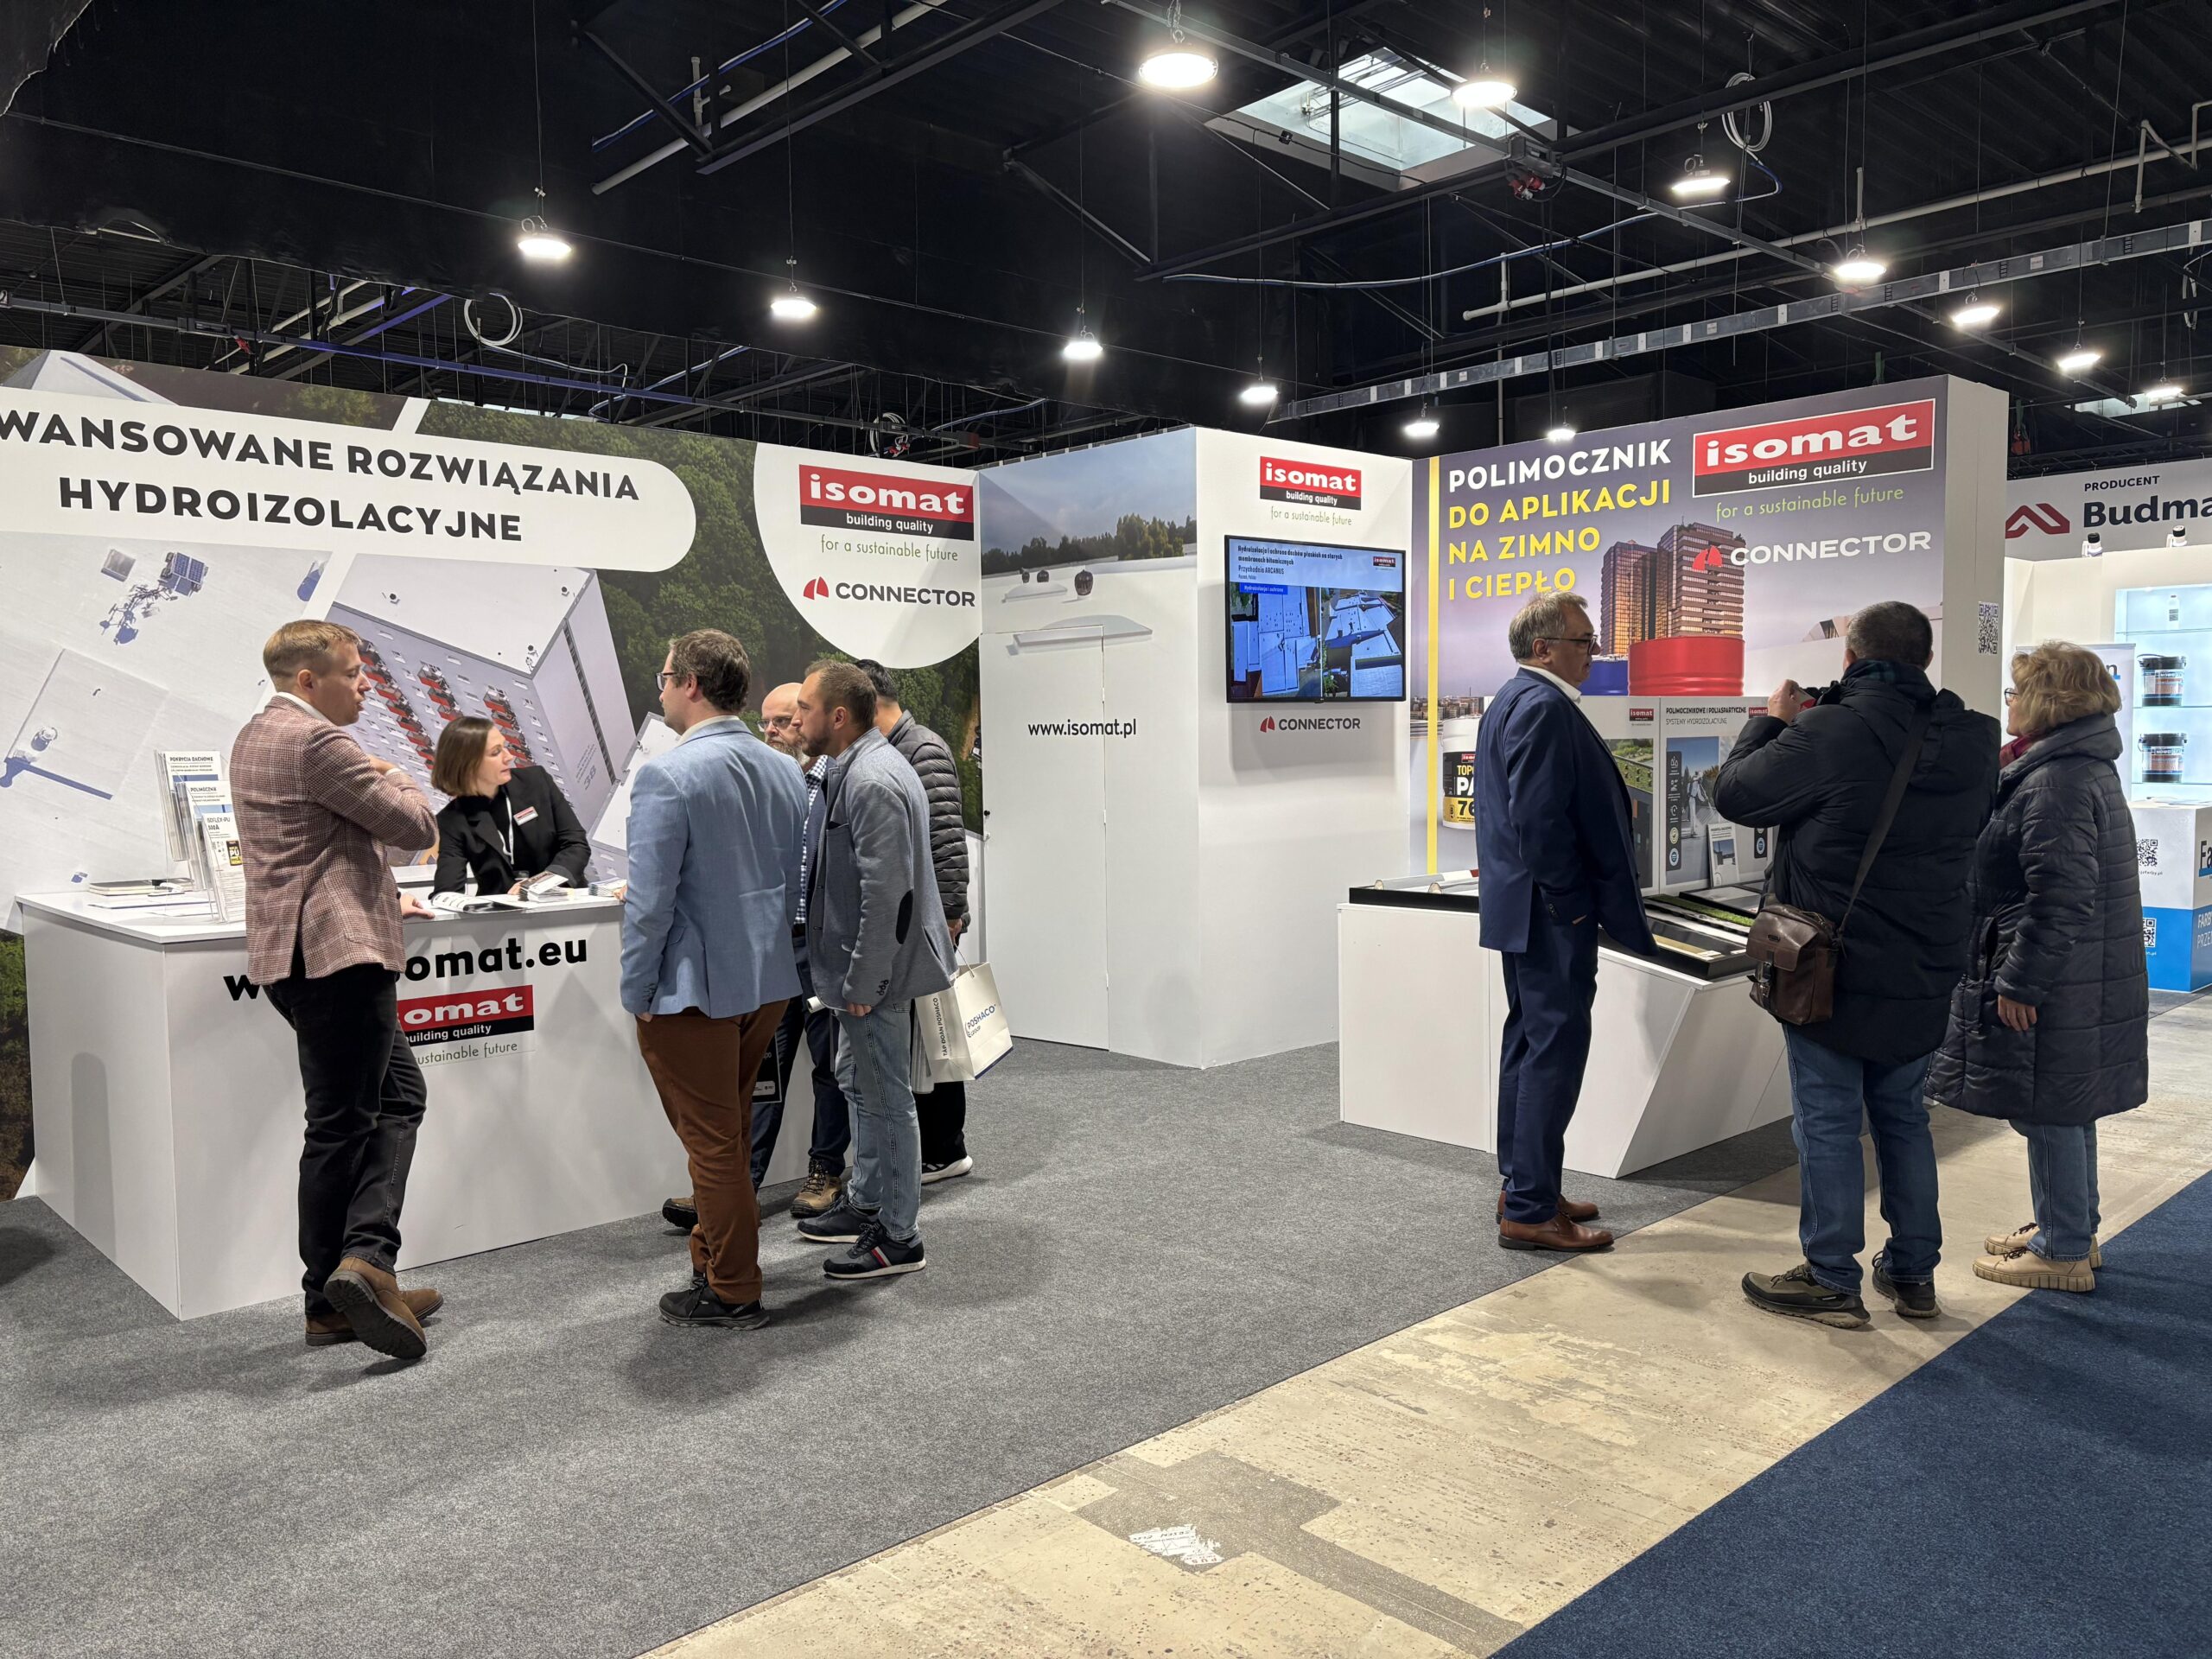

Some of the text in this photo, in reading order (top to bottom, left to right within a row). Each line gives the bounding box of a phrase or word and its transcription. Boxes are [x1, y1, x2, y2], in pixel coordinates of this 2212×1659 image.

[1707, 414, 1917, 467] isomat
[0, 410, 640, 501] WANSOWANE ROZWIĄZANIA
[1449, 438, 1672, 493] POLIMOCZNIK
[1266, 462, 1356, 492] isomat
[1748, 460, 1867, 485] building quality
[2084, 475, 2160, 492] PRODUCENT
[810, 474, 965, 514] isomat
[1286, 491, 1338, 506] building quality
[1449, 479, 1669, 529] DO APLIKACJI
[1716, 486, 1904, 522] for a sustainable future
[60, 477, 523, 542] HYDROIZOLACYJNE
[847, 513, 933, 534] building quality
[1271, 505, 1281, 520] for
[1292, 511, 1331, 524] sustainable
[1332, 512, 1351, 525] future
[822, 534, 958, 562] for a sustainable future
[1449, 526, 1600, 564] NA ZIMNO
[1730, 531, 1931, 566] CONNECTOR
[1238, 564, 1265, 575] Przychodnia
[1449, 567, 1575, 601] I CIEPŁO
[836, 582, 976, 607] CONNECTOR
[1028, 719, 1137, 738] www.isomat.pl
[1279, 718, 1361, 731] CONNECTOR
[224, 938, 588, 1001] womat.eu
[398, 992, 524, 1026] omat
[967, 1004, 995, 1030] POSHACO
[452, 1024, 492, 1038] quality
[416, 1041, 518, 1065] ustainable future
